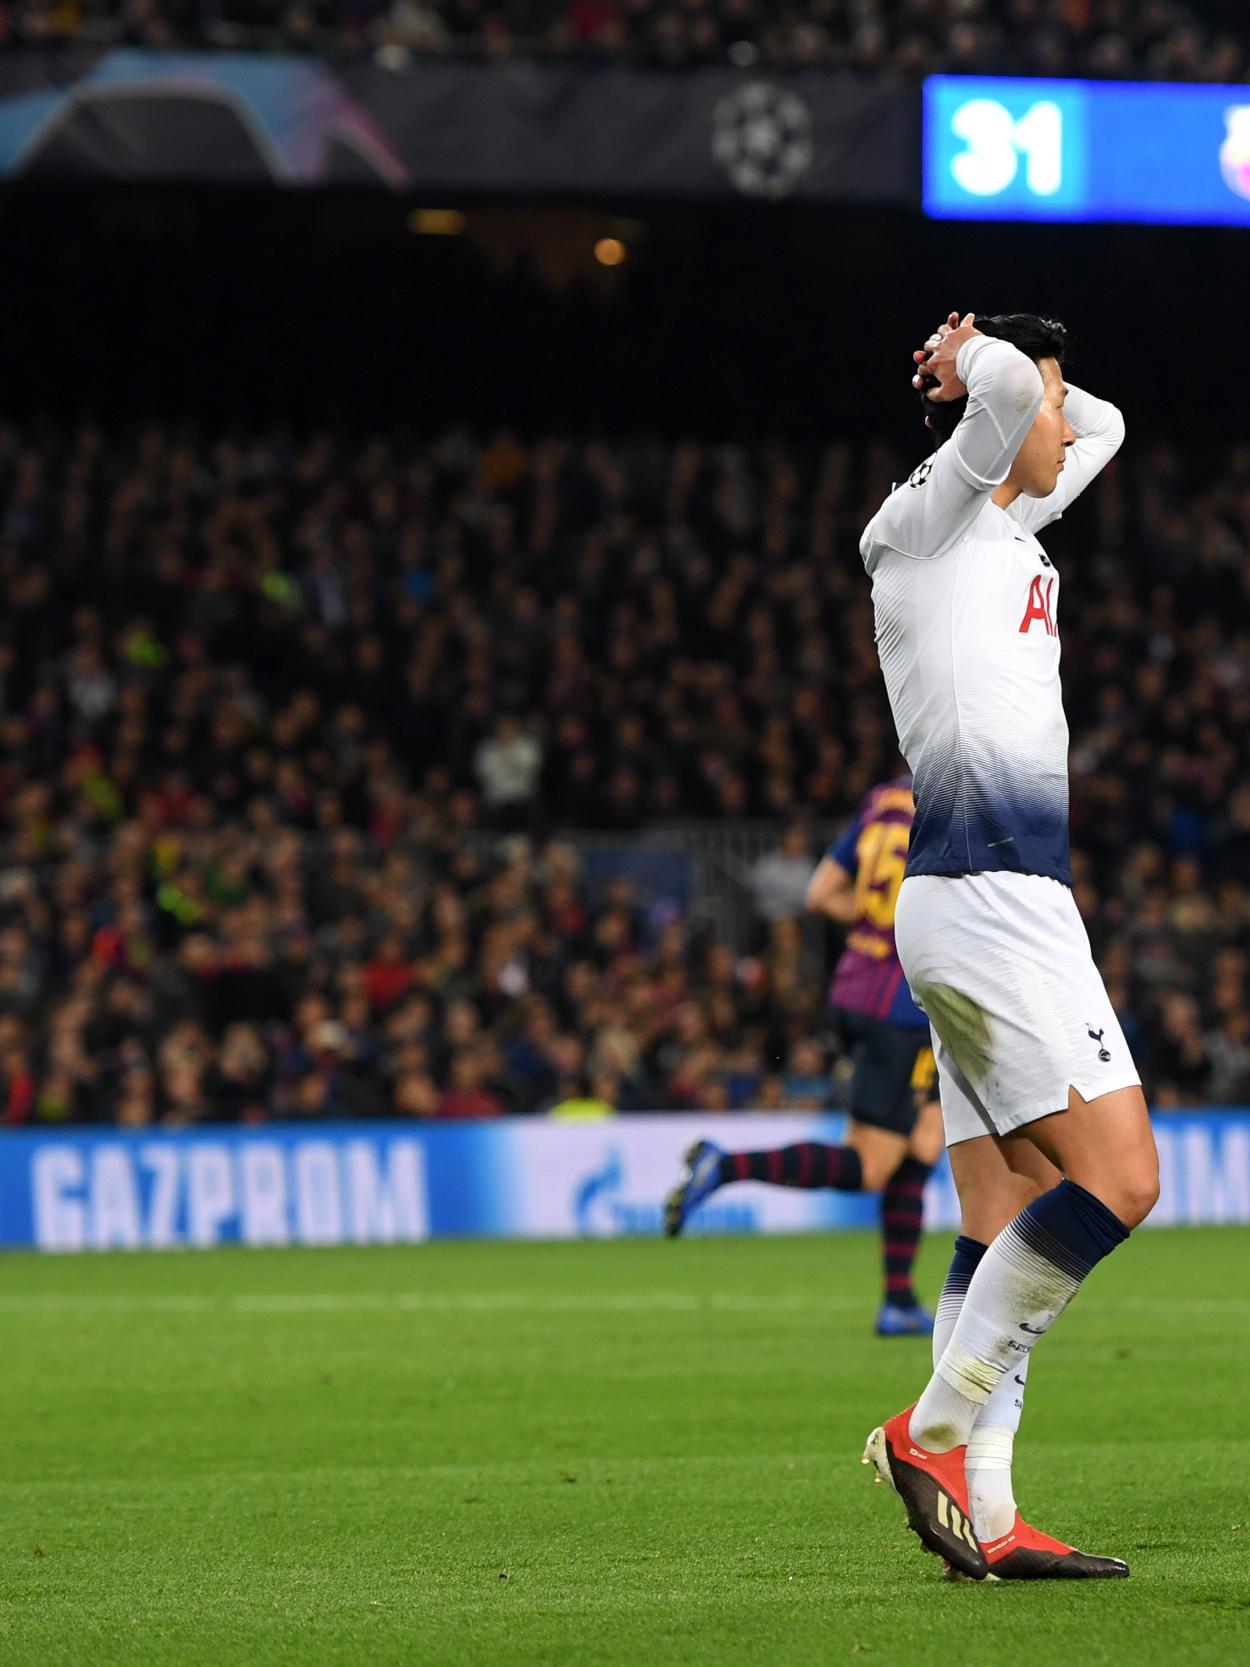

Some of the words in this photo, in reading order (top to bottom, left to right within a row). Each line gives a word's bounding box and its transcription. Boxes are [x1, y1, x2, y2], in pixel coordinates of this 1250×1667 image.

[951, 98, 1062, 196] 31
[855, 820, 911, 930] 15
[31, 1140, 430, 1251] GAZPROM
